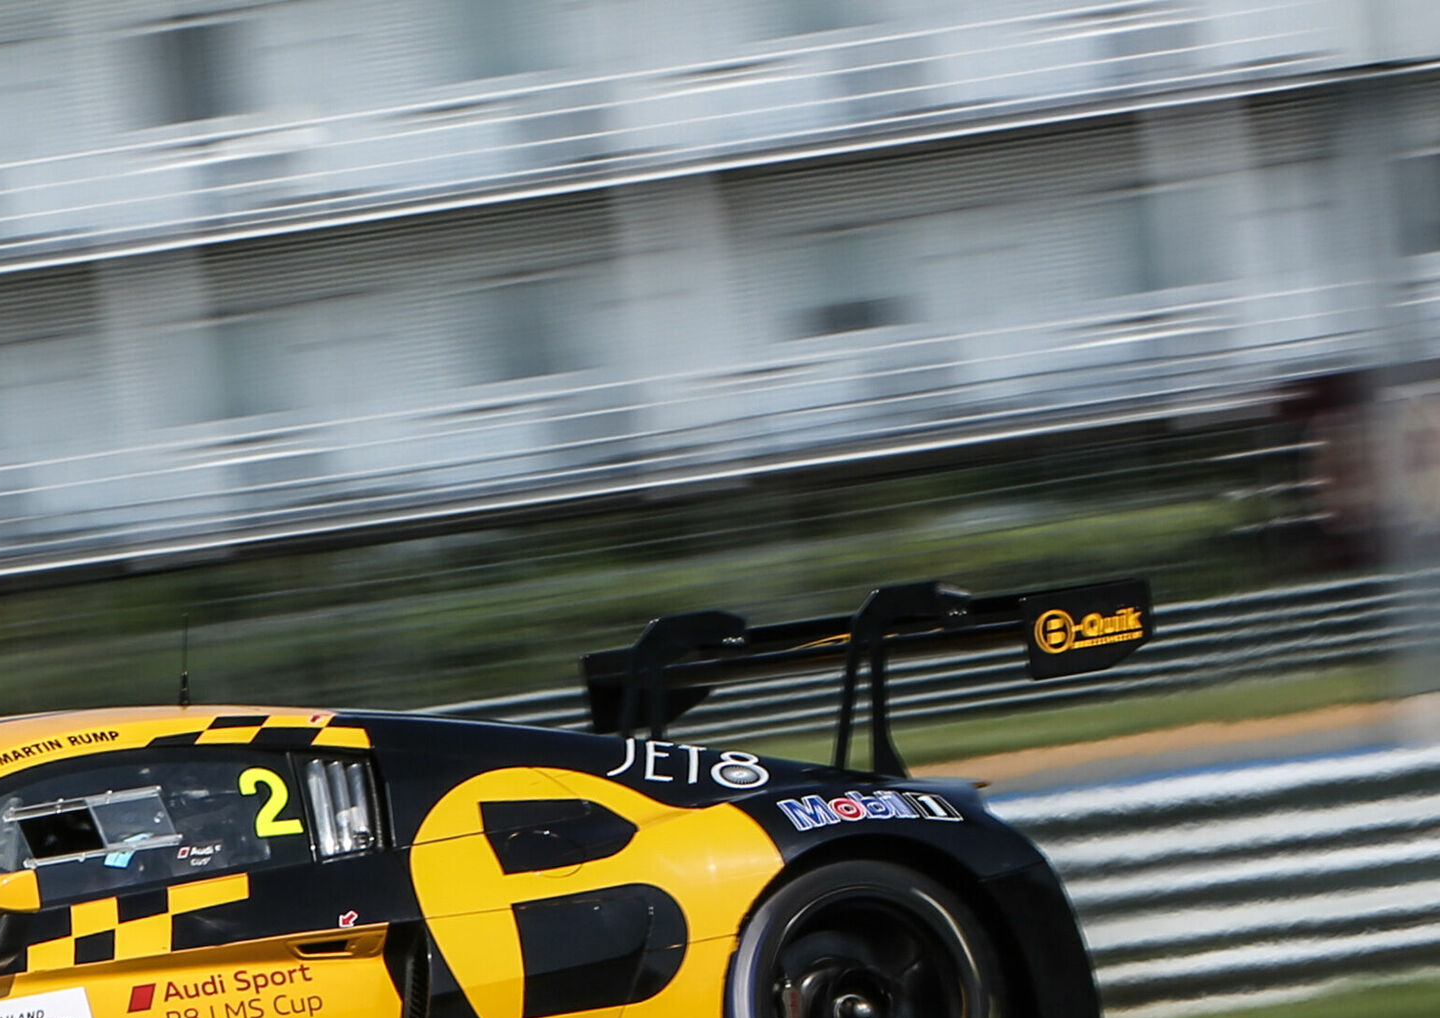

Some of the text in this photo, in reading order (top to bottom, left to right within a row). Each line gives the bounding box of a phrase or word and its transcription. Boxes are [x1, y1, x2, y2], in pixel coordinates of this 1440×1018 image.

[67, 730, 120, 747] RUMP
[607, 738, 769, 788] JET8
[239, 767, 304, 837] 2
[777, 791, 964, 831] Mobil 1
[163, 964, 313, 1002] Audi Sport
[274, 994, 323, 1017] Cup
